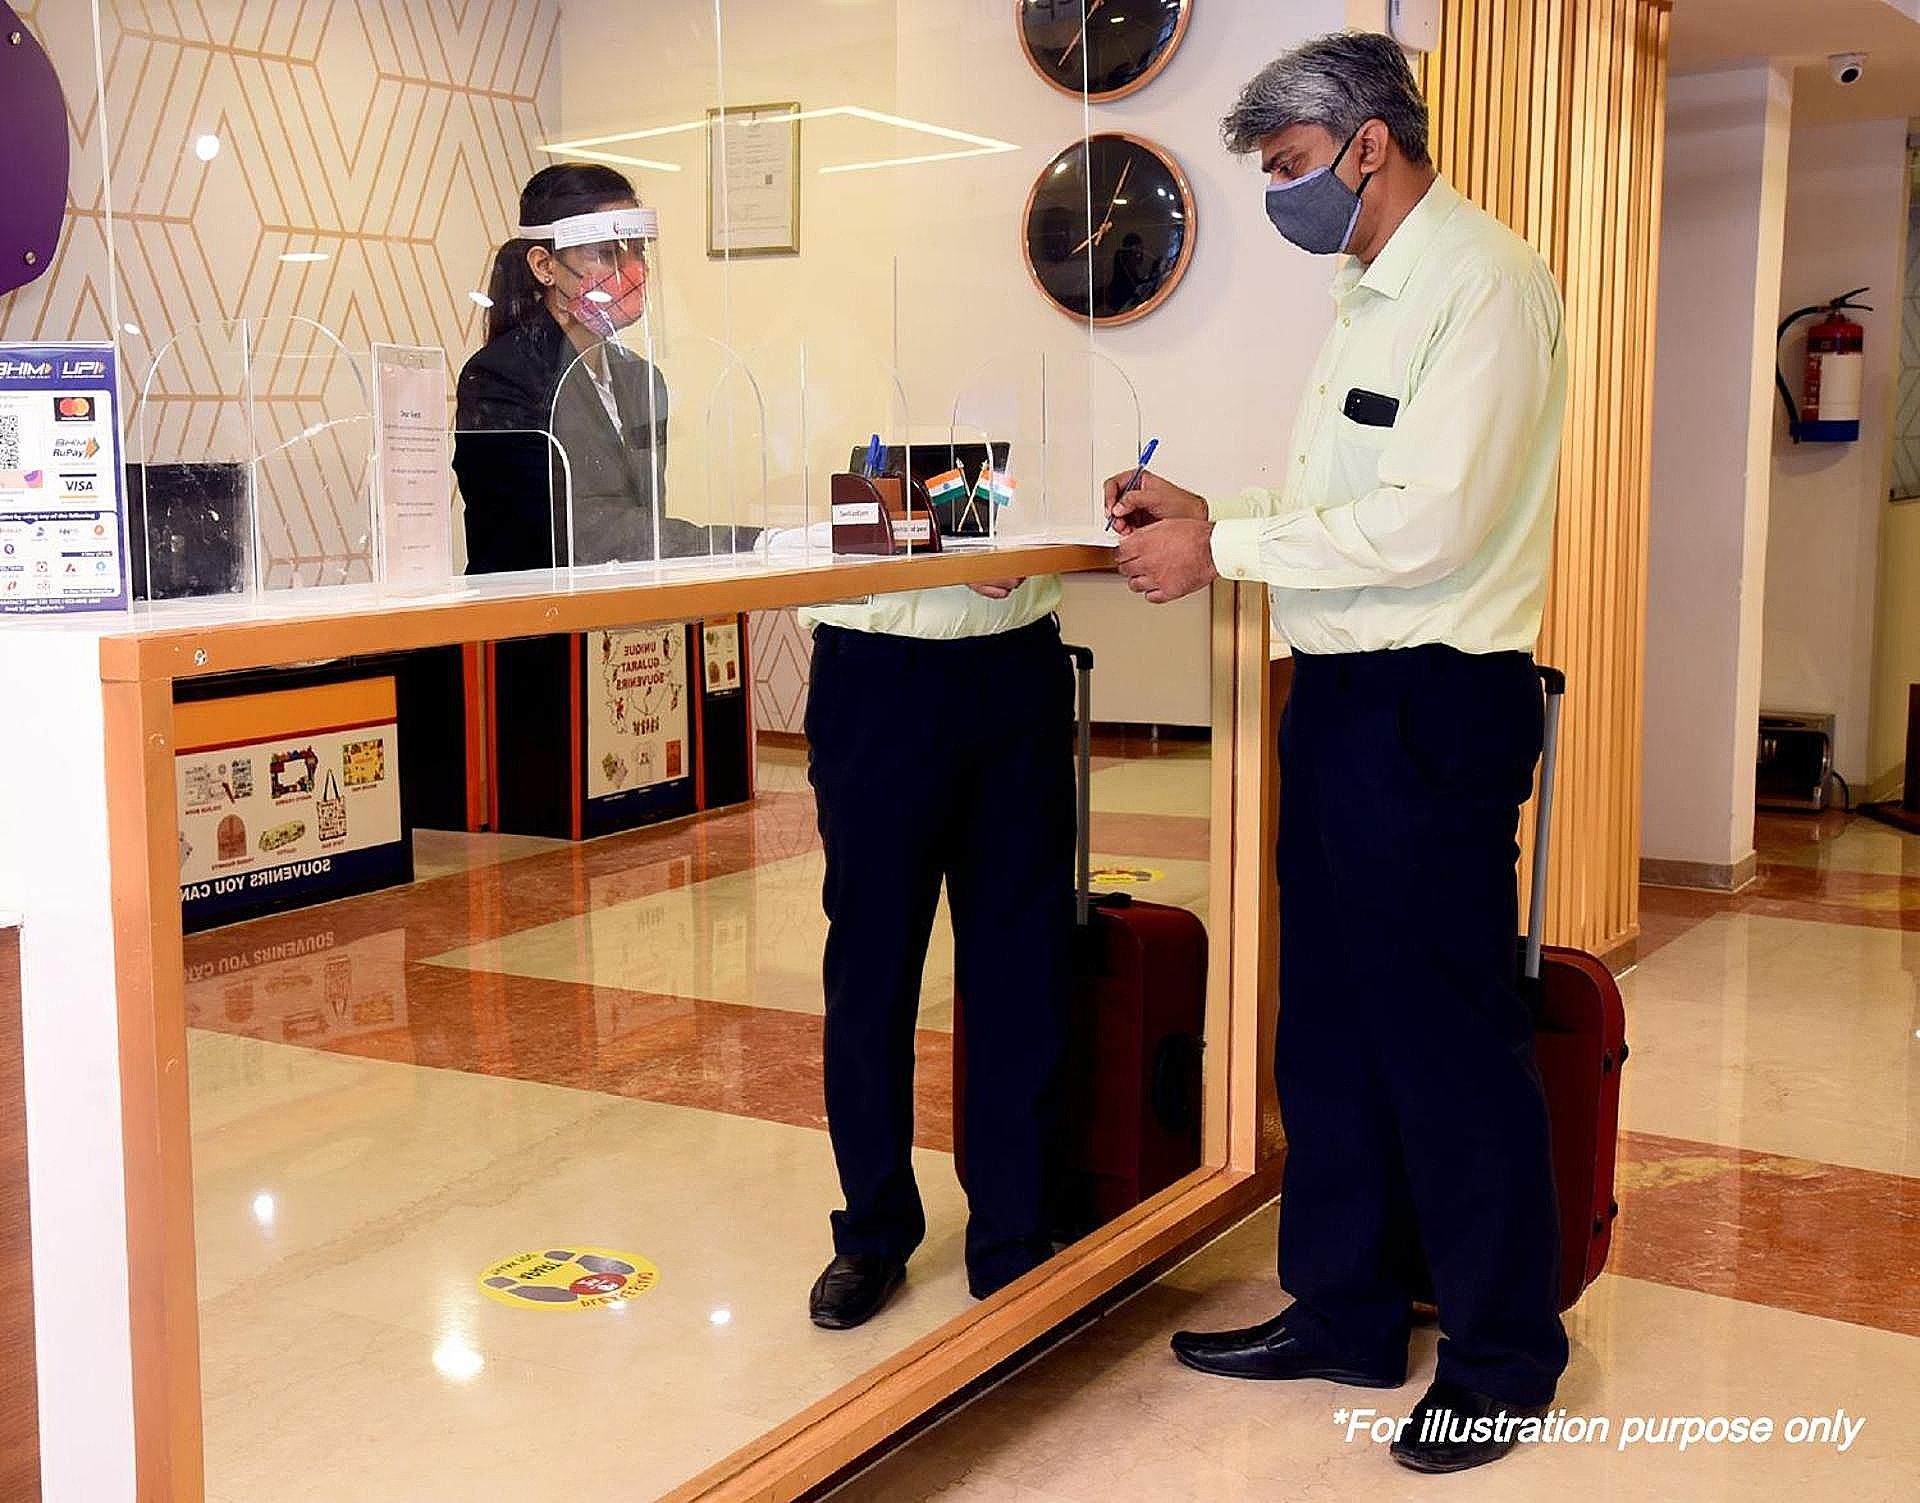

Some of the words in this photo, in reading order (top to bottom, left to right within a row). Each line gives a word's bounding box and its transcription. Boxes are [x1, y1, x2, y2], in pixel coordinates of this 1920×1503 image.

[62, 361, 101, 375] UPI
[53, 448, 83, 459] RuPay
[65, 480, 93, 491] VISA
